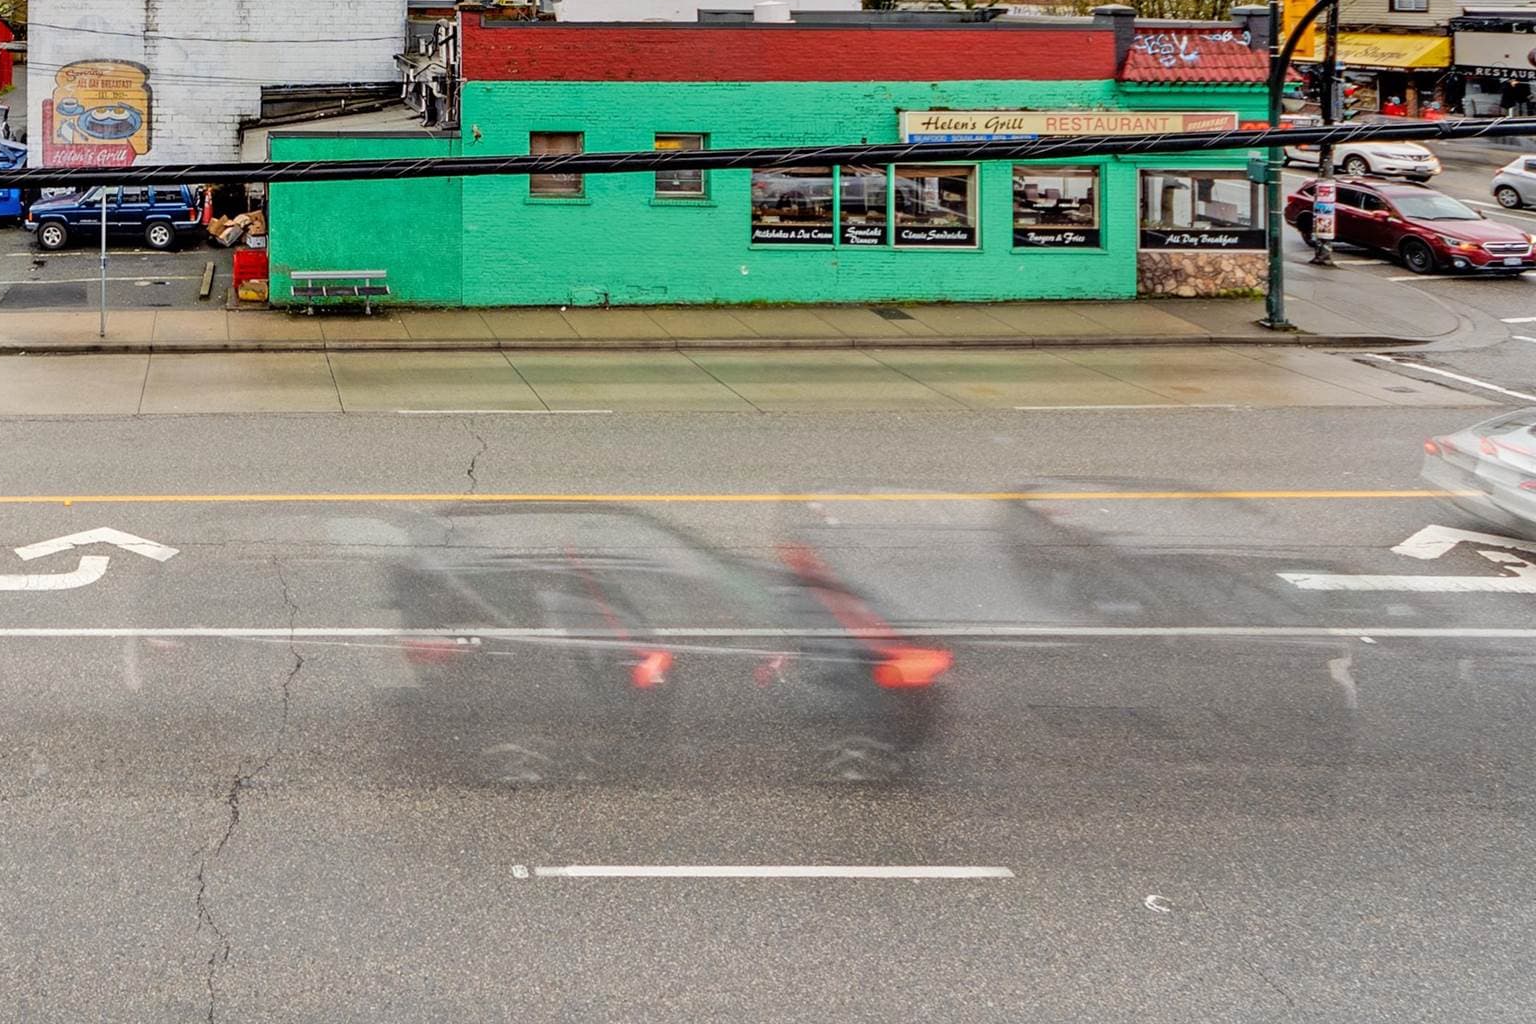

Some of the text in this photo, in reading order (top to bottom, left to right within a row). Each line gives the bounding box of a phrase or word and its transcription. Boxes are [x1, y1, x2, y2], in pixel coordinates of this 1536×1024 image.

[921, 116, 977, 130] Helen's
[985, 116, 1024, 133] Grill
[1046, 117, 1169, 131] RESTAURANT
[97, 149, 127, 164] Grill
[1165, 233, 1239, 246] All Day Breakfast
